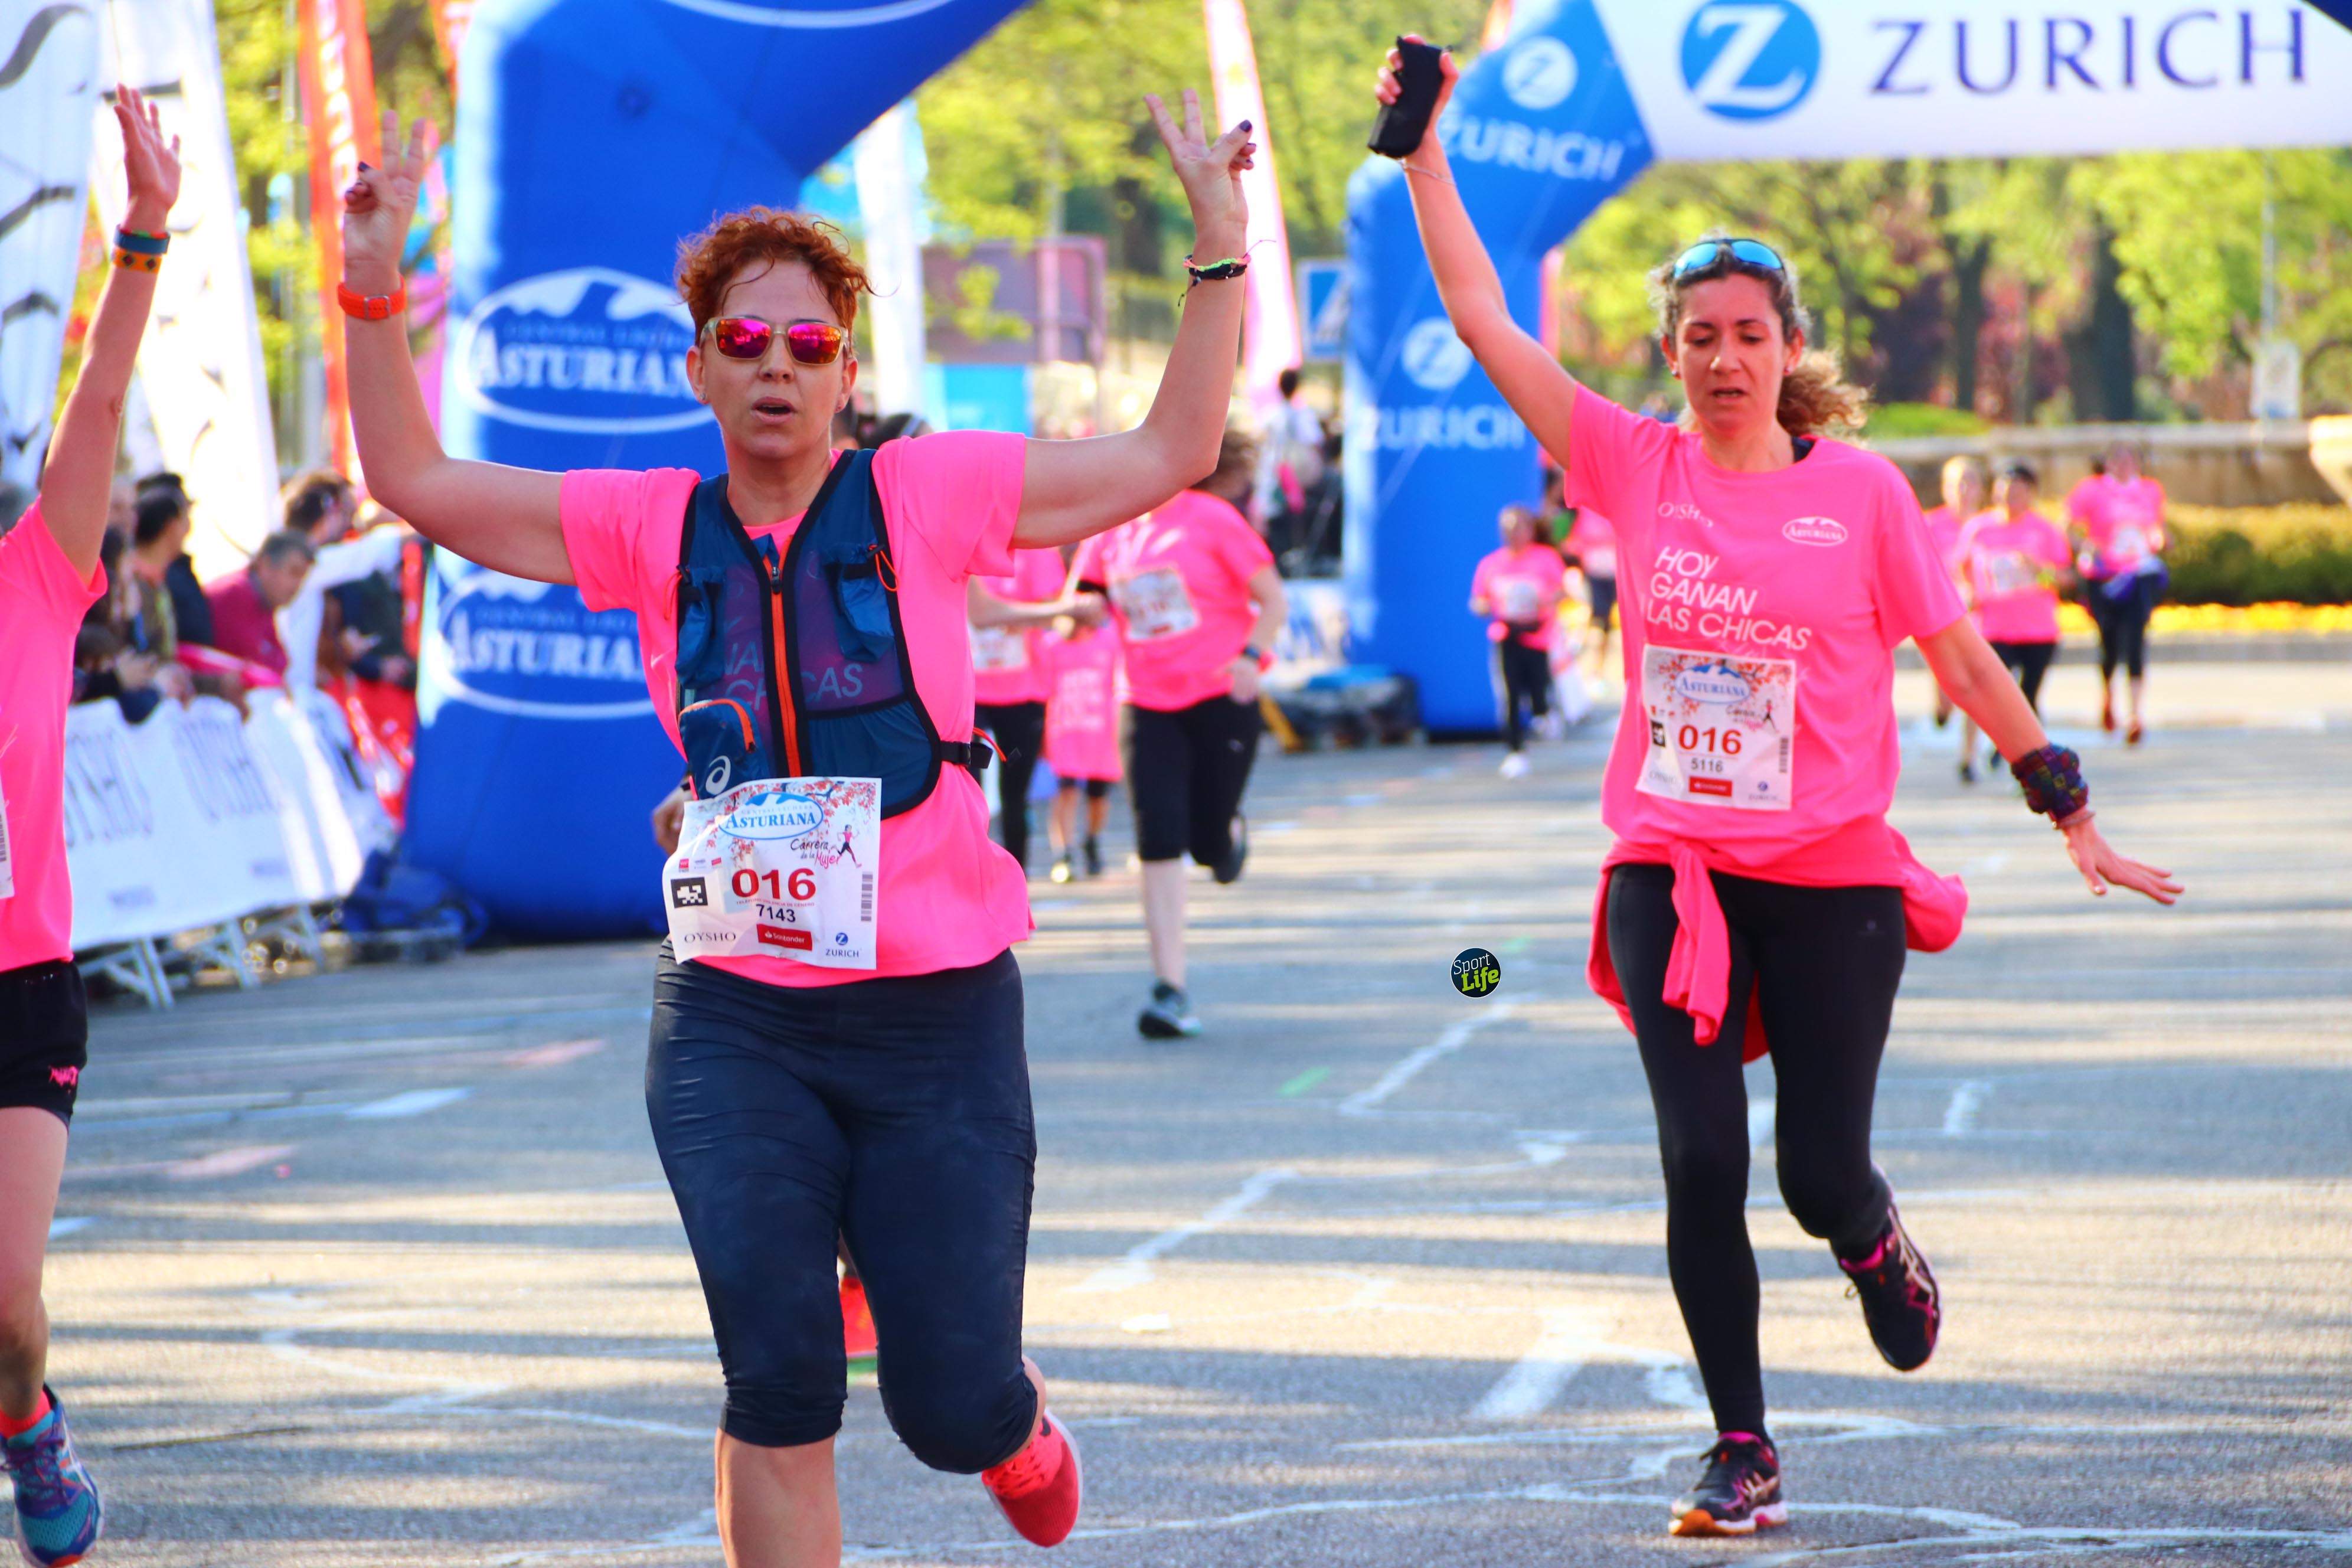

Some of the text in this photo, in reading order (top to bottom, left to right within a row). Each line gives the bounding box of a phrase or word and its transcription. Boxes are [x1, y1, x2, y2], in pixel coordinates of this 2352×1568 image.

[1869, 8, 2307, 95] ZURICH
[1654, 546, 1719, 579] HOY
[1650, 571, 1758, 615] GANAN
[1647, 599, 1812, 651] LAS CHICAS
[450, 607, 645, 681] ASTURIA
[1682, 677, 1745, 697] ASTURIANA
[1678, 724, 1742, 755] 016
[1691, 757, 1723, 773] 5116
[726, 811, 816, 829] ASTURIANA
[790, 838, 829, 851] Carrera
[809, 851, 815, 859] la
[815, 850, 841, 869] Mujer
[731, 868, 816, 900] 016
[756, 904, 796, 922] 7143
[684, 932, 736, 943] OYSHO
[773, 933, 805, 943] Santander
[825, 949, 859, 958] ZURICH
